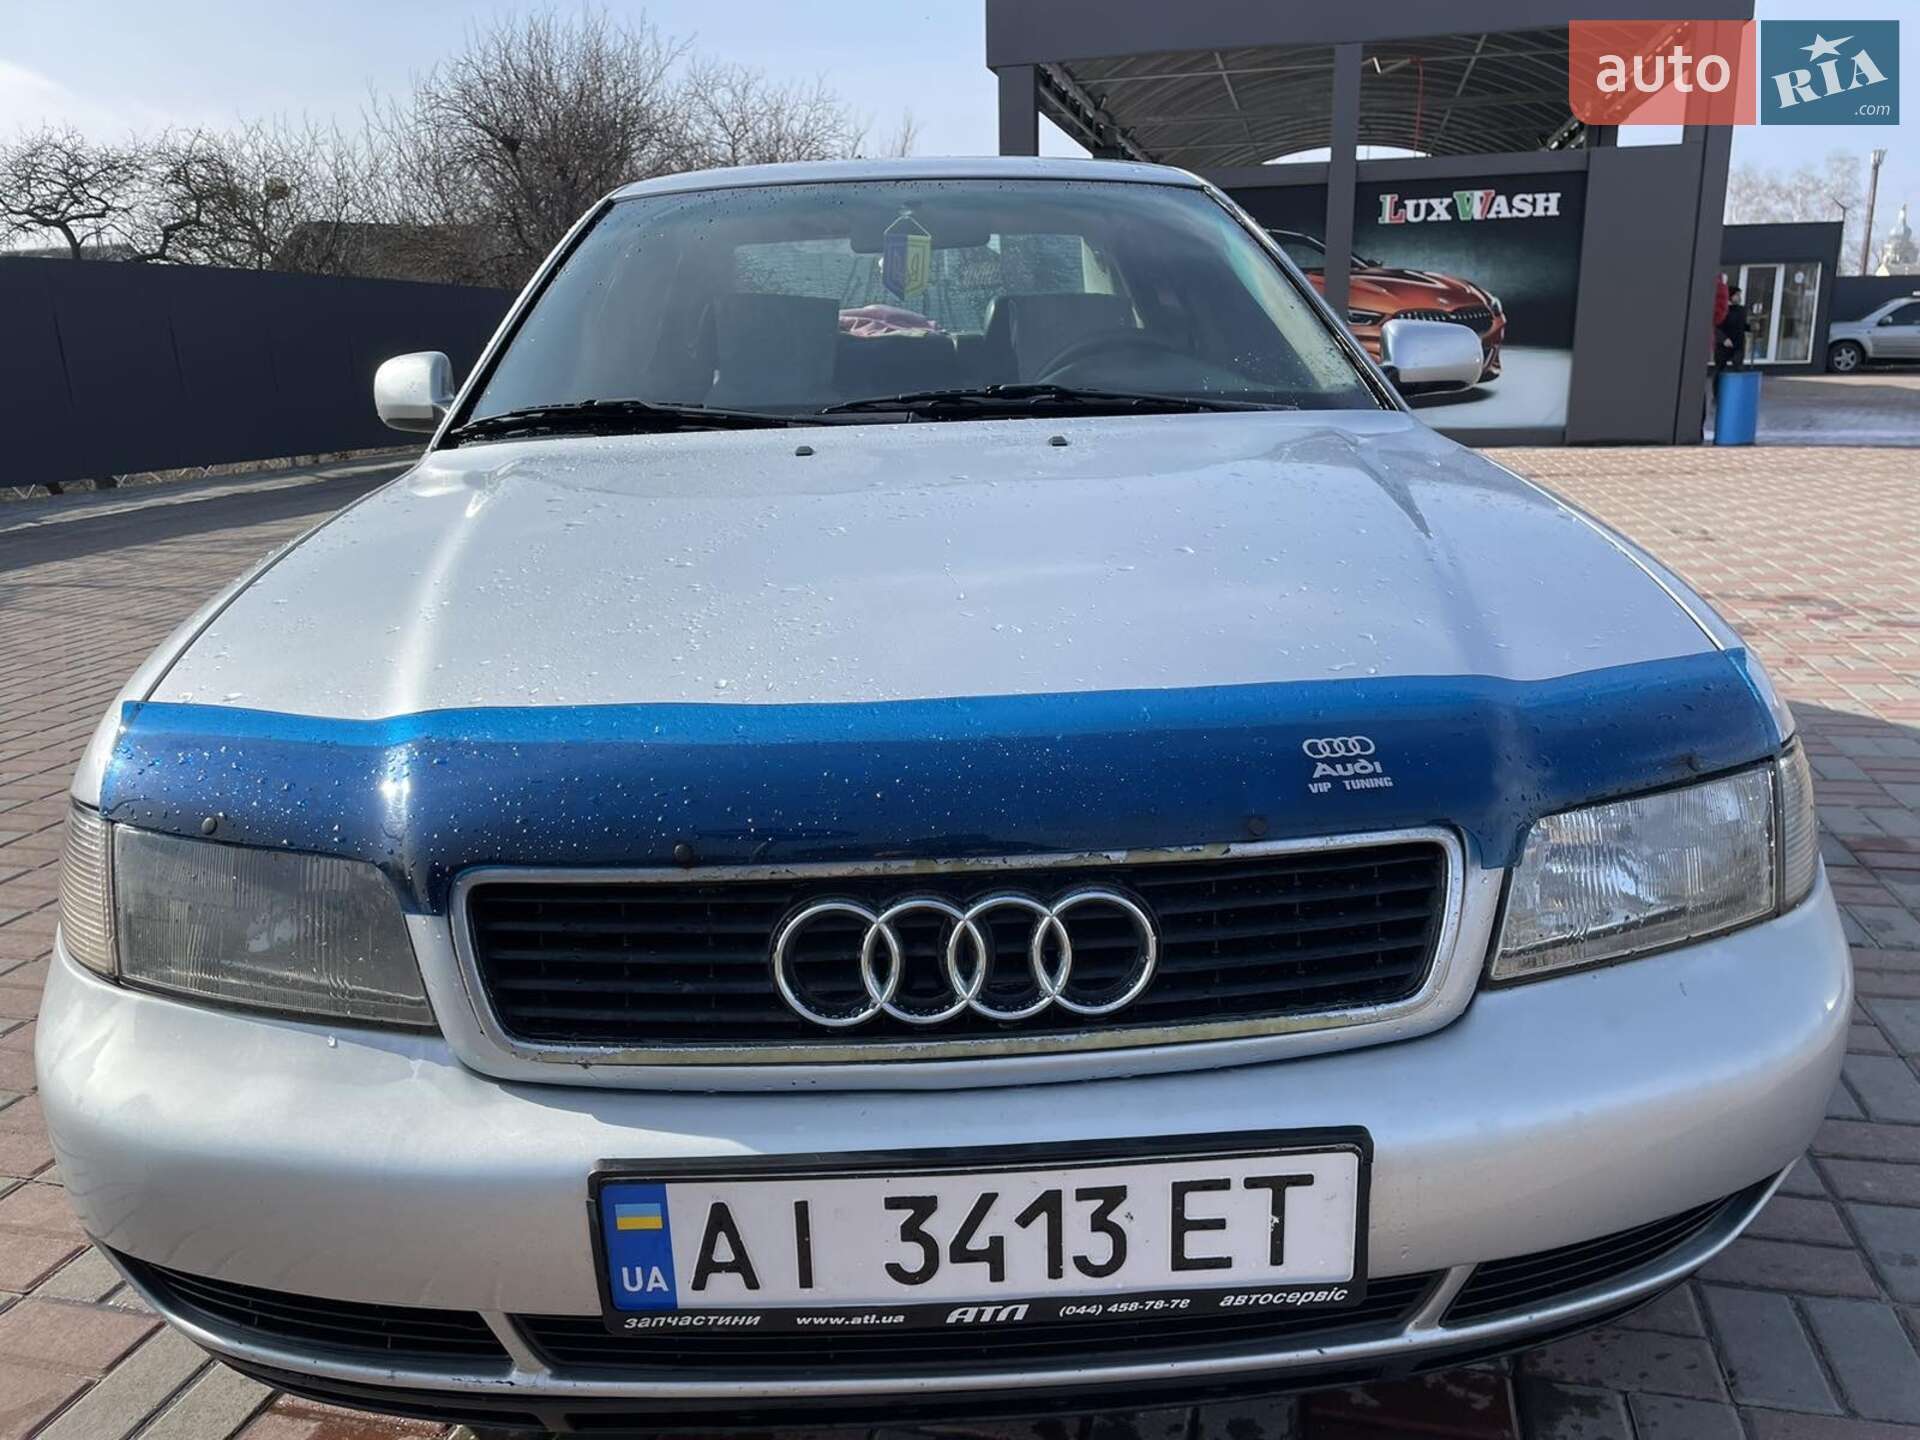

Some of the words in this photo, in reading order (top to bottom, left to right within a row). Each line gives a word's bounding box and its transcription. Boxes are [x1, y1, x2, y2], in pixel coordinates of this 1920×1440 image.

[1308, 782, 1331, 793] VIP
[1343, 777, 1394, 790] TUNING
[691, 1200, 814, 1291] AI
[884, 1184, 1128, 1285] 3413
[1171, 1174, 1315, 1272] ET
[621, 1266, 669, 1292] UA
[1059, 1304, 1103, 1317] (044)
[1107, 1298, 1191, 1313] 458-78-78
[624, 1314, 761, 1329] запчастини
